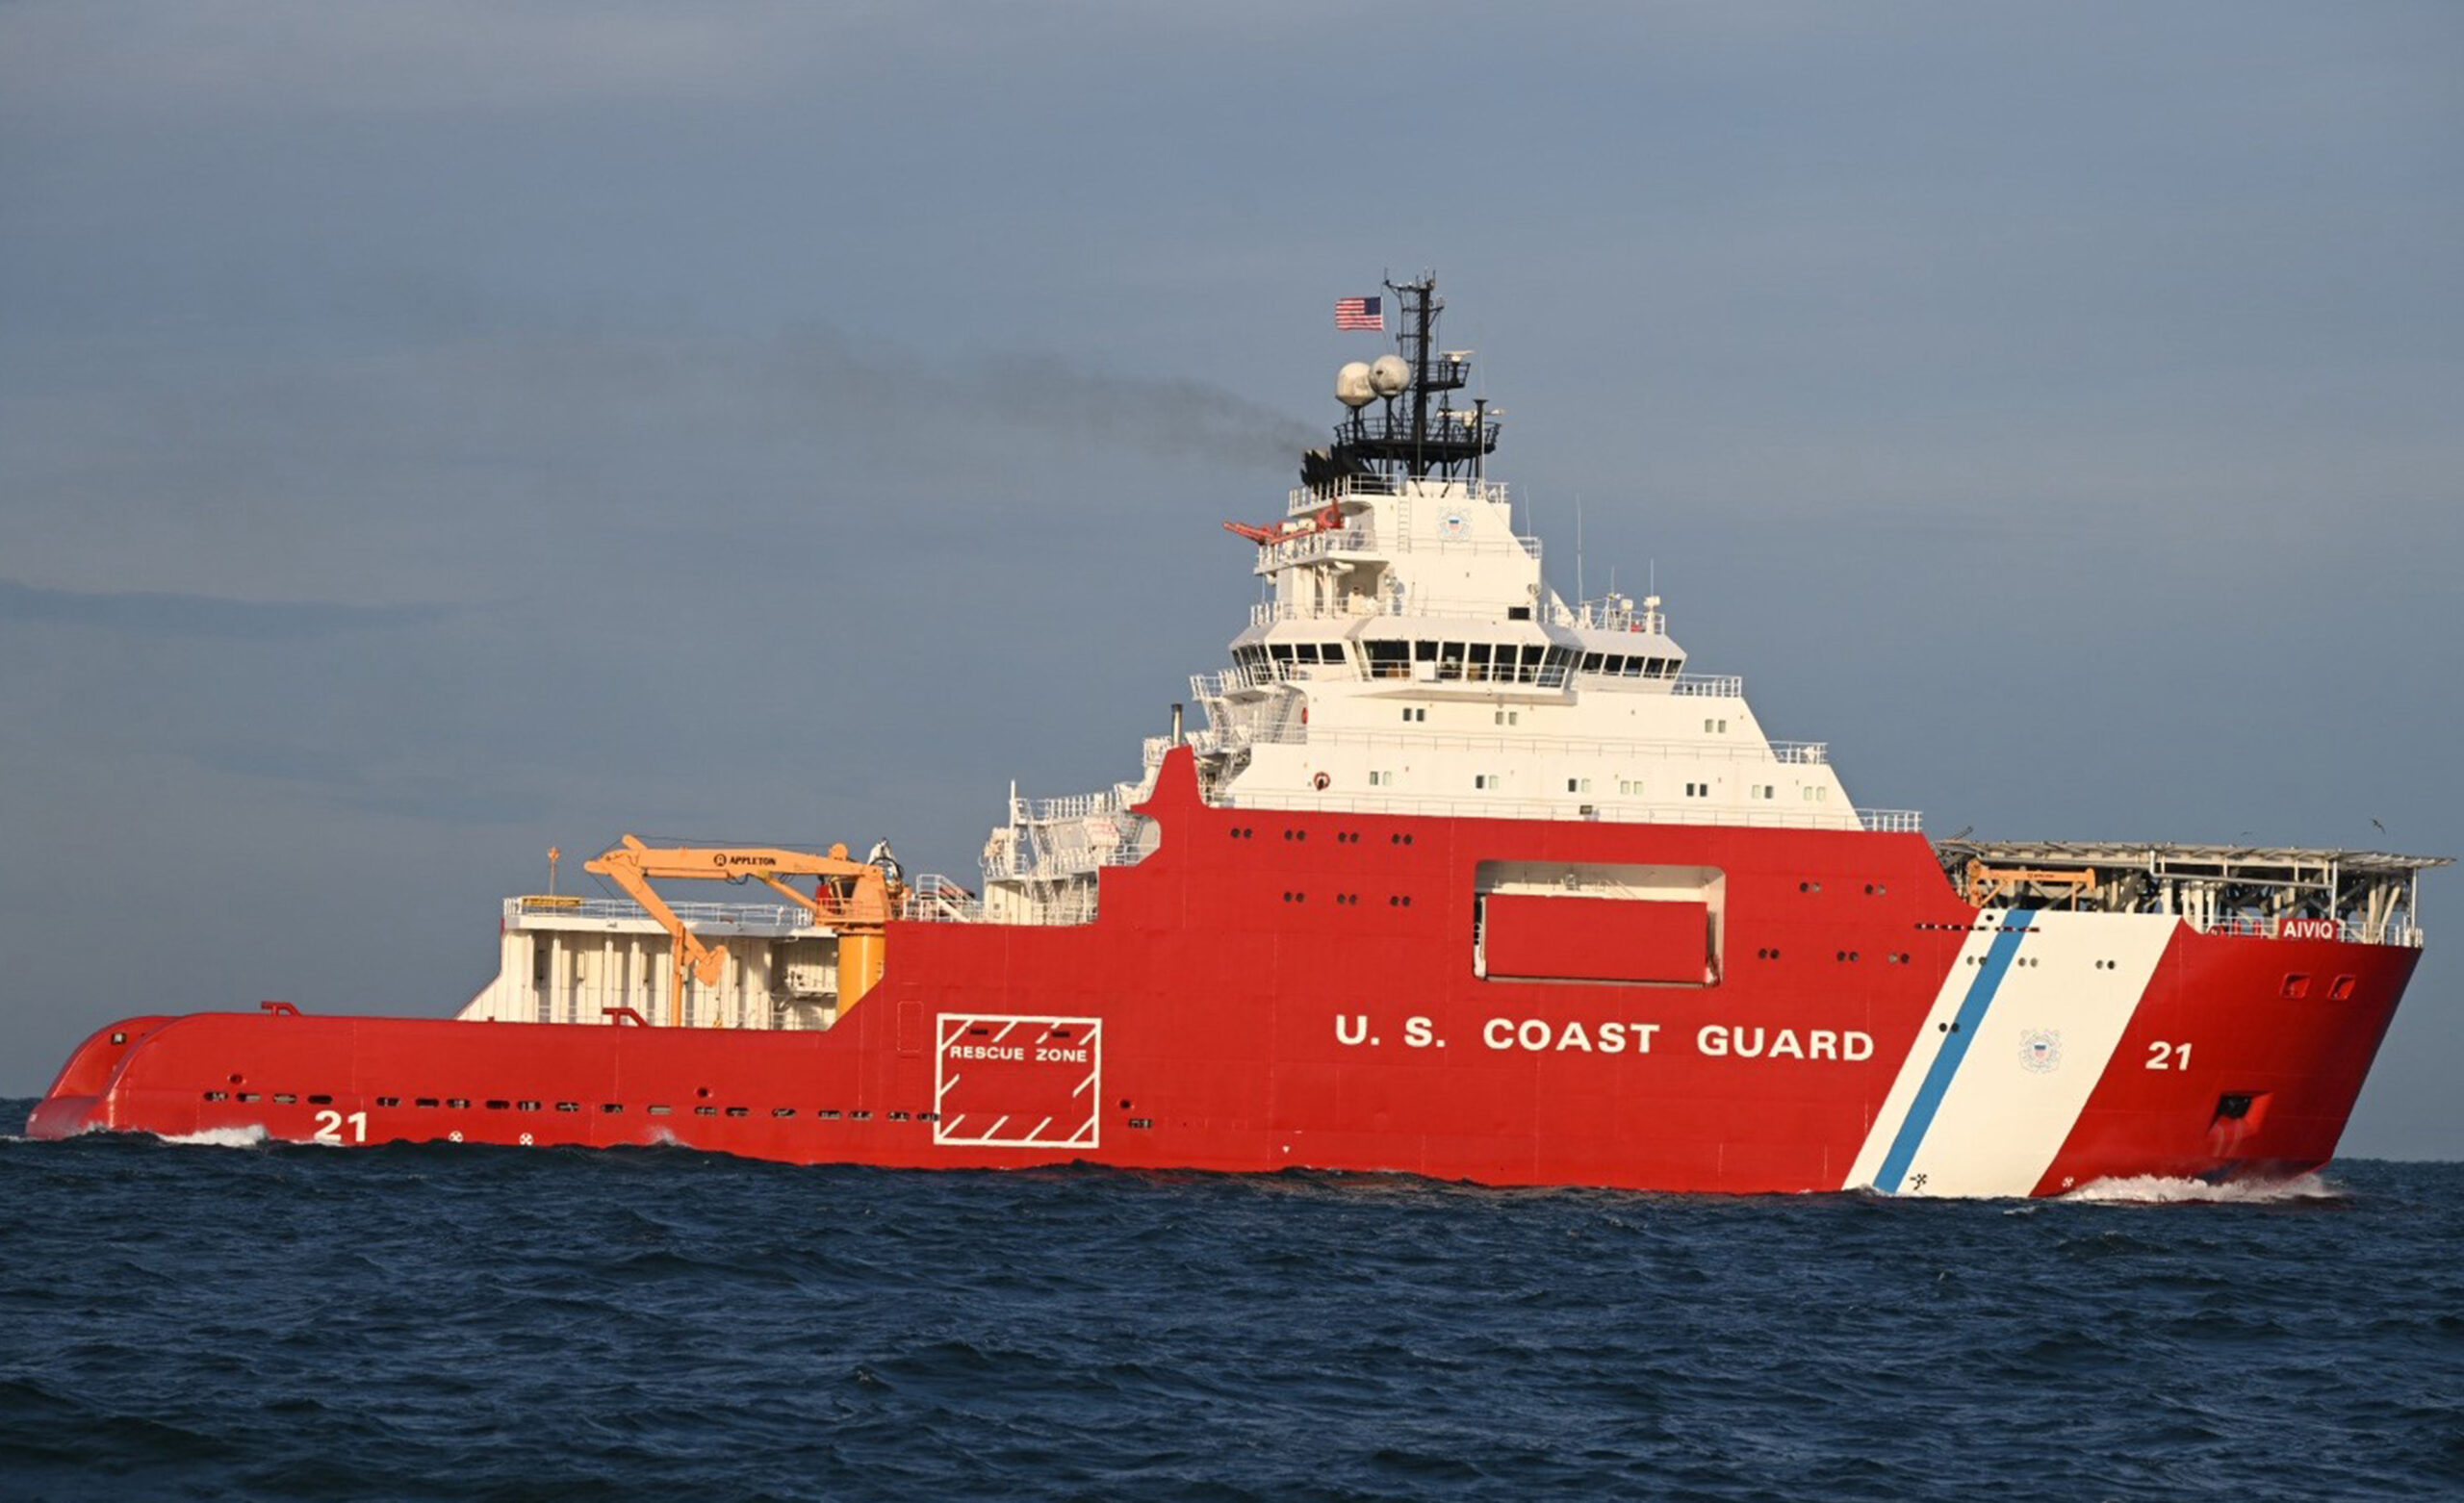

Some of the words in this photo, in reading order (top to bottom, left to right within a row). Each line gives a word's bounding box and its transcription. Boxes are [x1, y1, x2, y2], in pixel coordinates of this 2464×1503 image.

[730, 855, 777, 866] APPLETON
[2283, 921, 2333, 939] AIVIQ
[1336, 1014, 1380, 1046] U.
[1404, 1016, 1446, 1048] S.
[1483, 1018, 1660, 1054] COAST
[1697, 1025, 1874, 1061] GUARD
[949, 1045, 1025, 1061] RESCUE
[1036, 1048, 1088, 1063] ZONE
[2145, 1040, 2192, 1071] 21
[313, 1109, 367, 1142] 21
